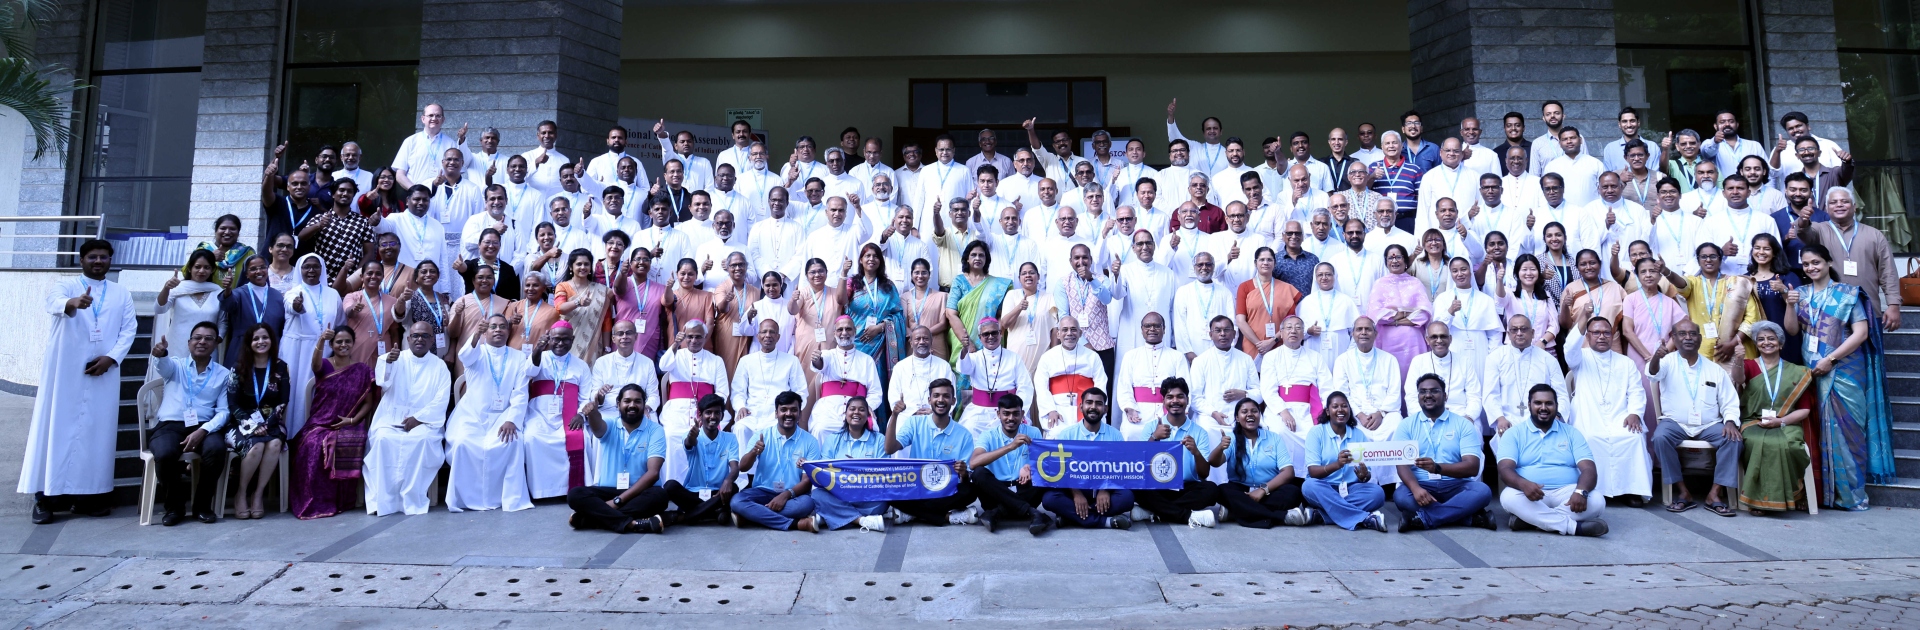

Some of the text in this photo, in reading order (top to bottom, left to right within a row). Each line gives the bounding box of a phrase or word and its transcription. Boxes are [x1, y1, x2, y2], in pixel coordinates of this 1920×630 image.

[626, 128, 651, 140] ional
[693, 134, 731, 149] Assembly
[1363, 449, 1403, 458] communio
[1069, 460, 1145, 473] communio
[838, 471, 917, 484] communio
